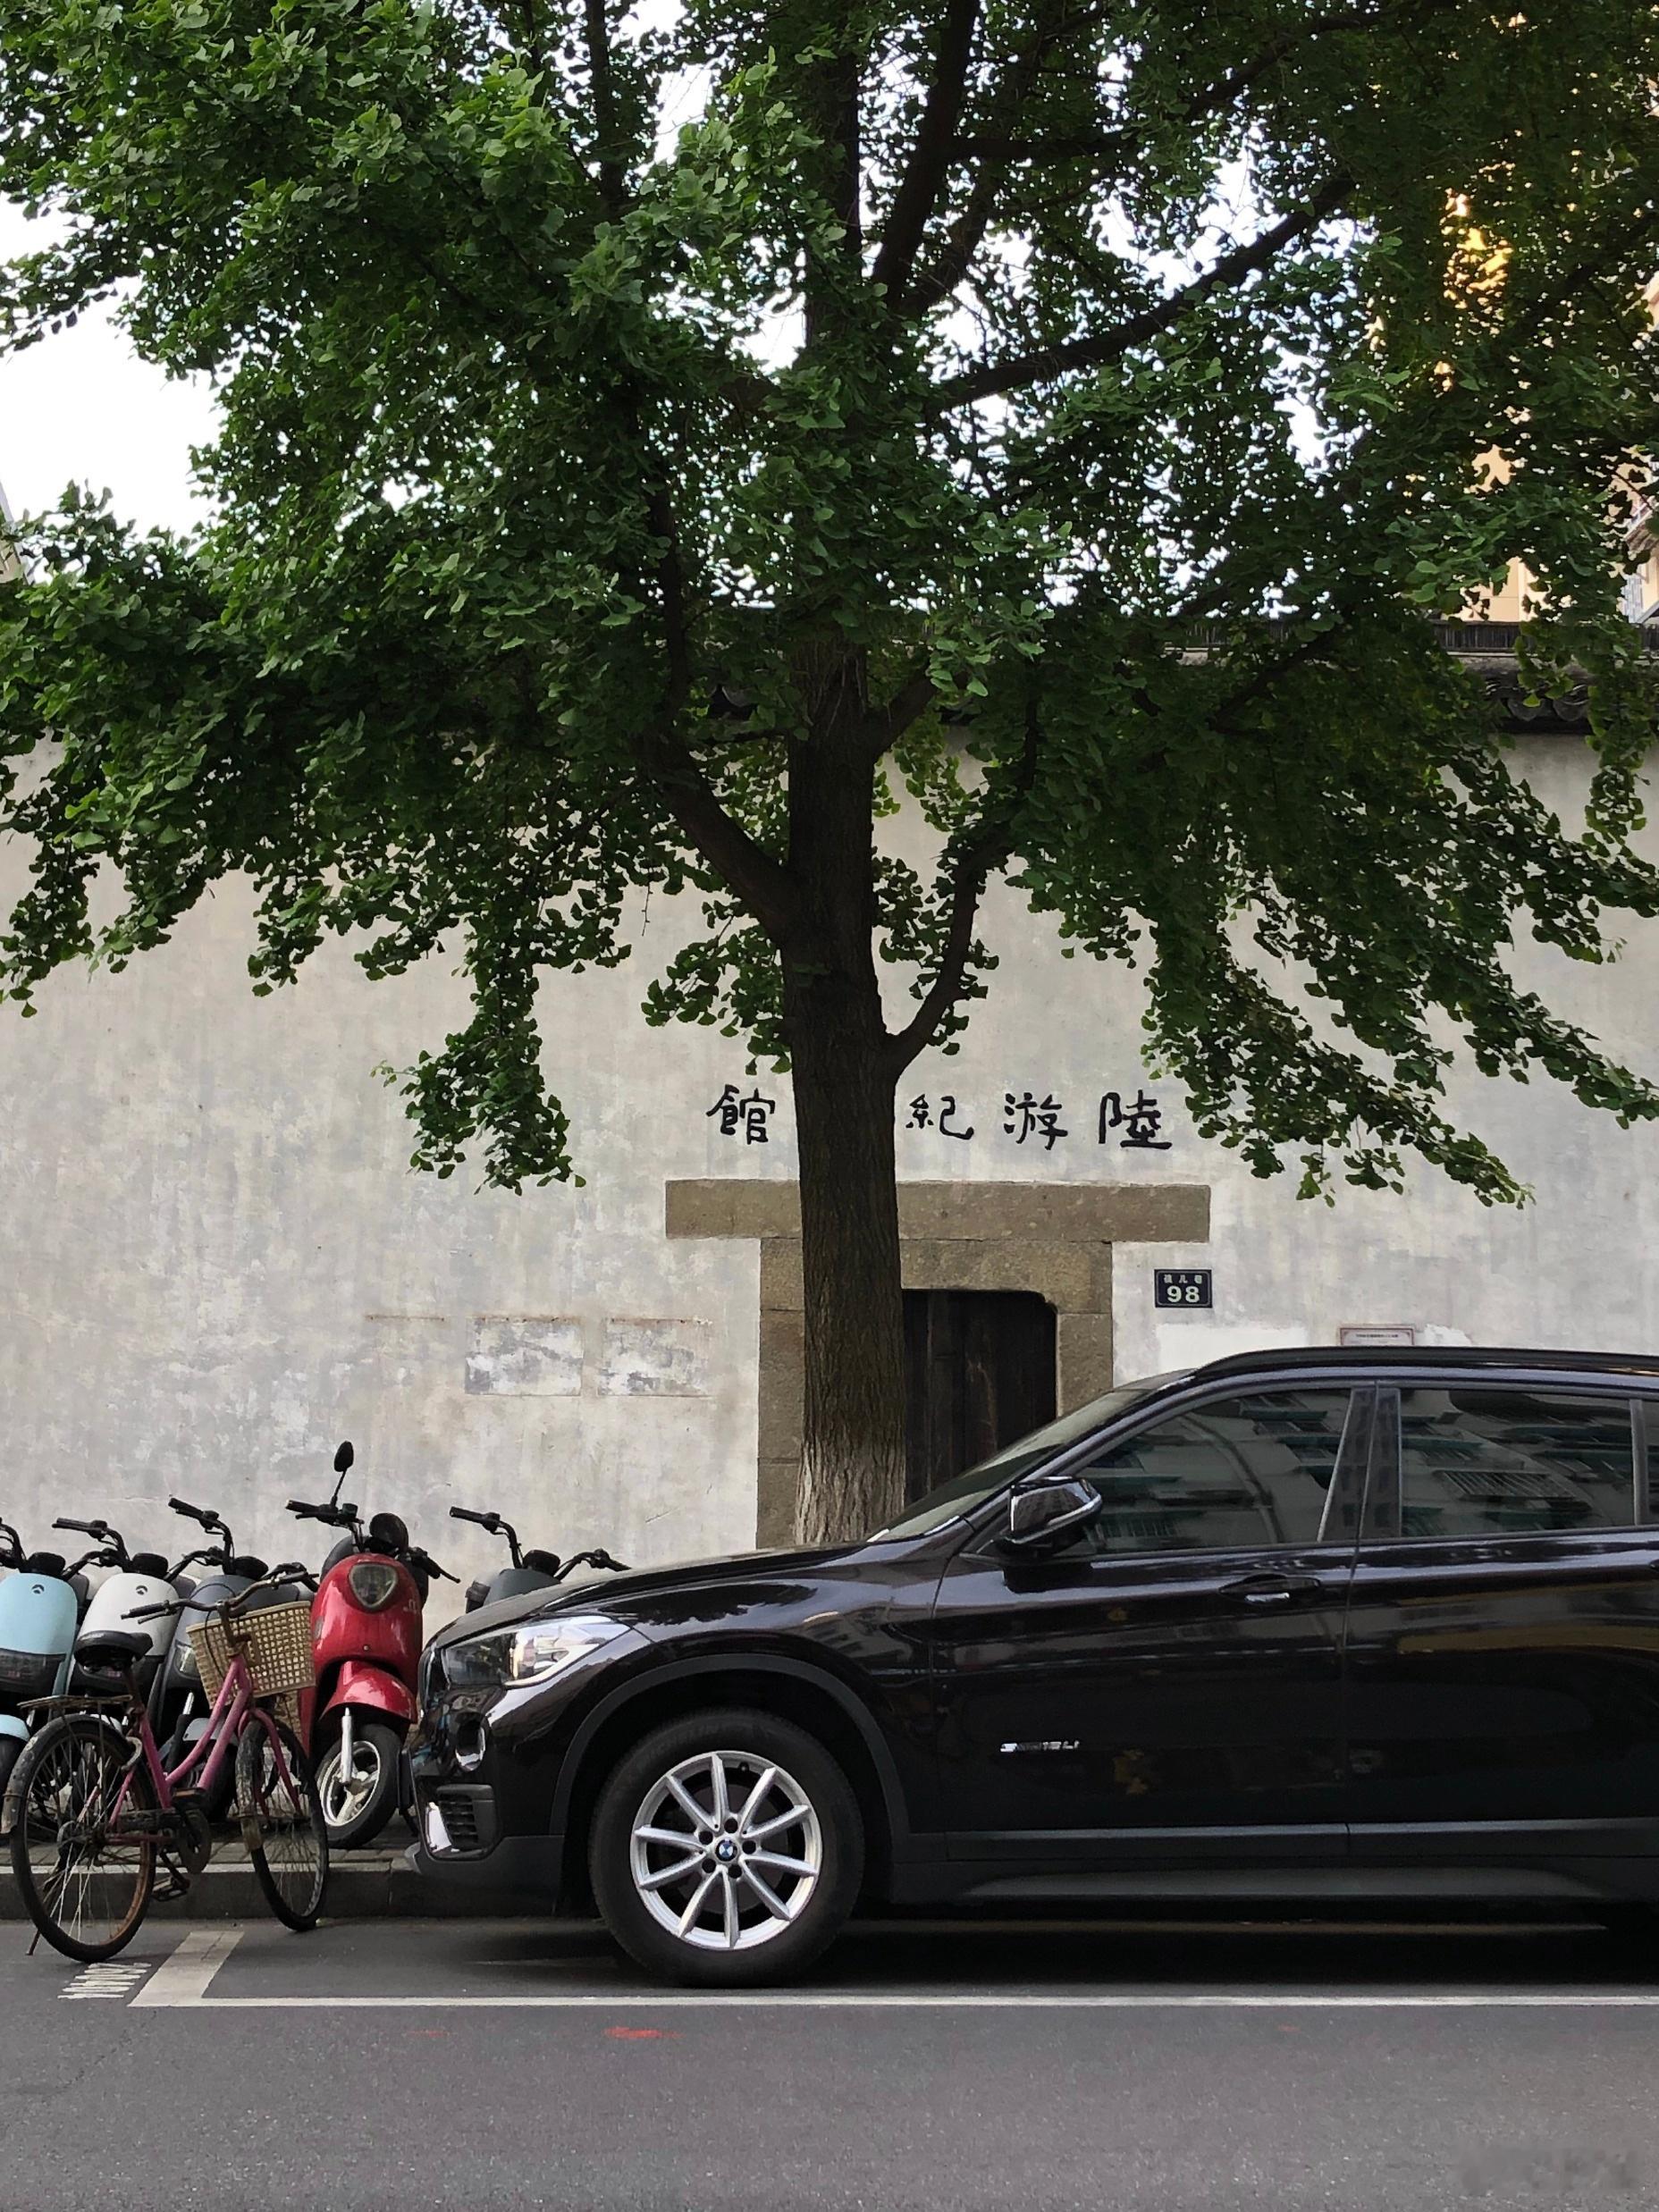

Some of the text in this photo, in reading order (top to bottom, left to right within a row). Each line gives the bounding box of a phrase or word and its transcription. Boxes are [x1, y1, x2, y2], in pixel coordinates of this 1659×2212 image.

[706, 1084, 1173, 1150] 陸游紀館
[1166, 1285, 1200, 1303] 98
